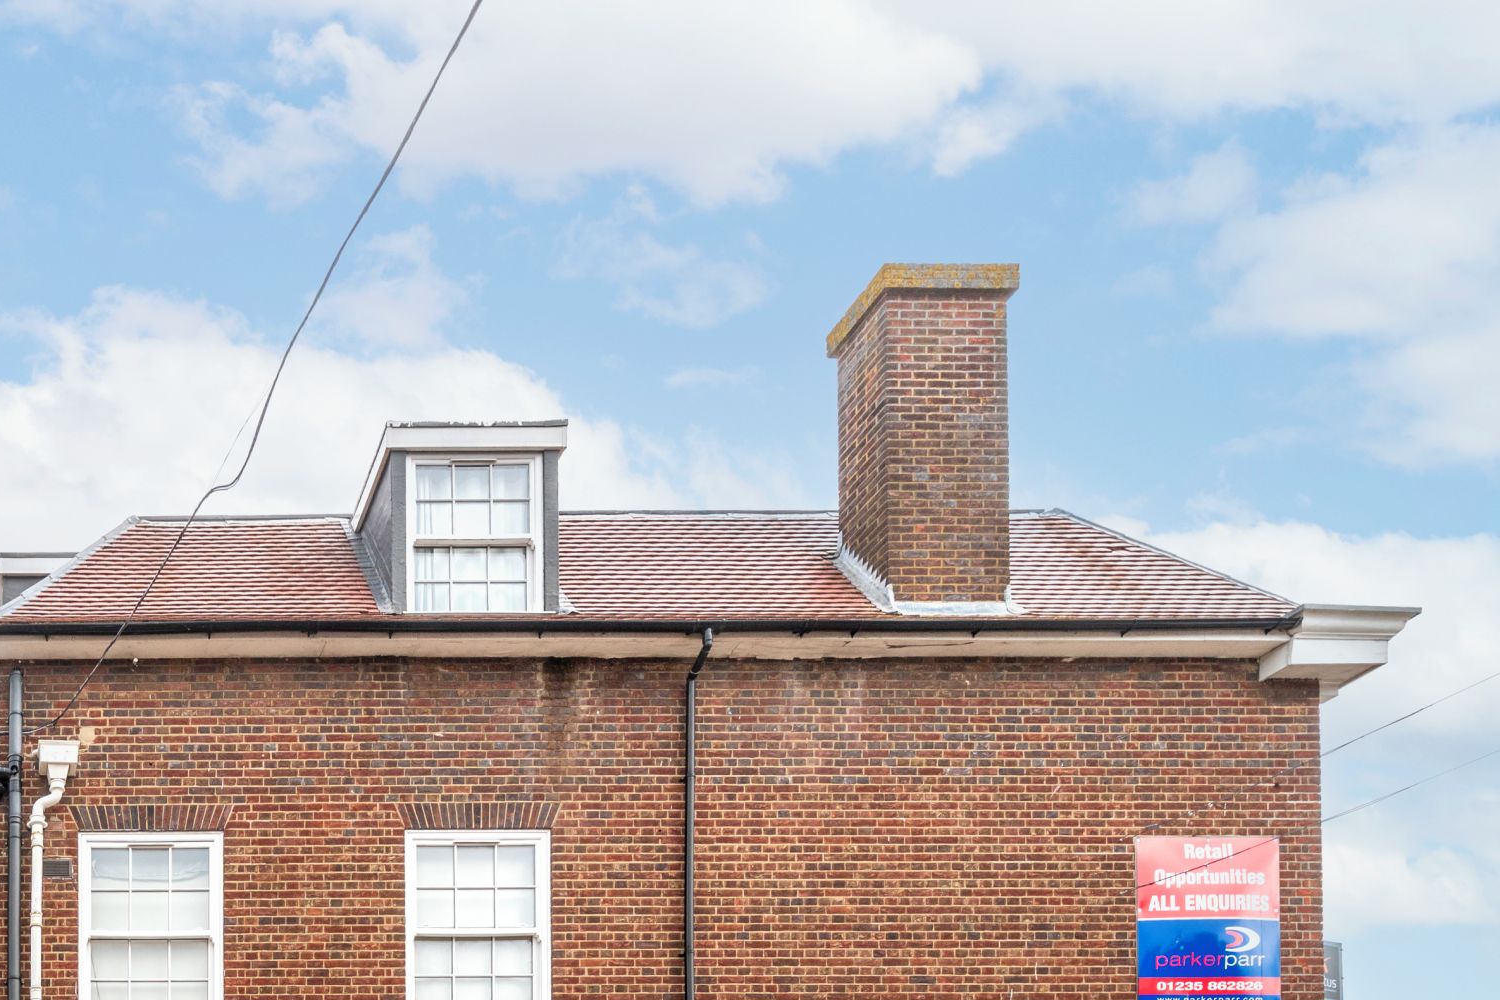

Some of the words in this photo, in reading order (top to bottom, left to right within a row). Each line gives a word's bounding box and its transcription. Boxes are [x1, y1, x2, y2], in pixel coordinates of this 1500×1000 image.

[1184, 843, 1233, 860] Retail
[1154, 869, 1265, 888] Opportunities
[1148, 895, 1180, 911] ALL
[1185, 894, 1269, 912] ENQUIRIES
[1155, 952, 1265, 970] parkerparr
[1156, 981, 1203, 991] 01235
[1207, 981, 1263, 991] 862826
